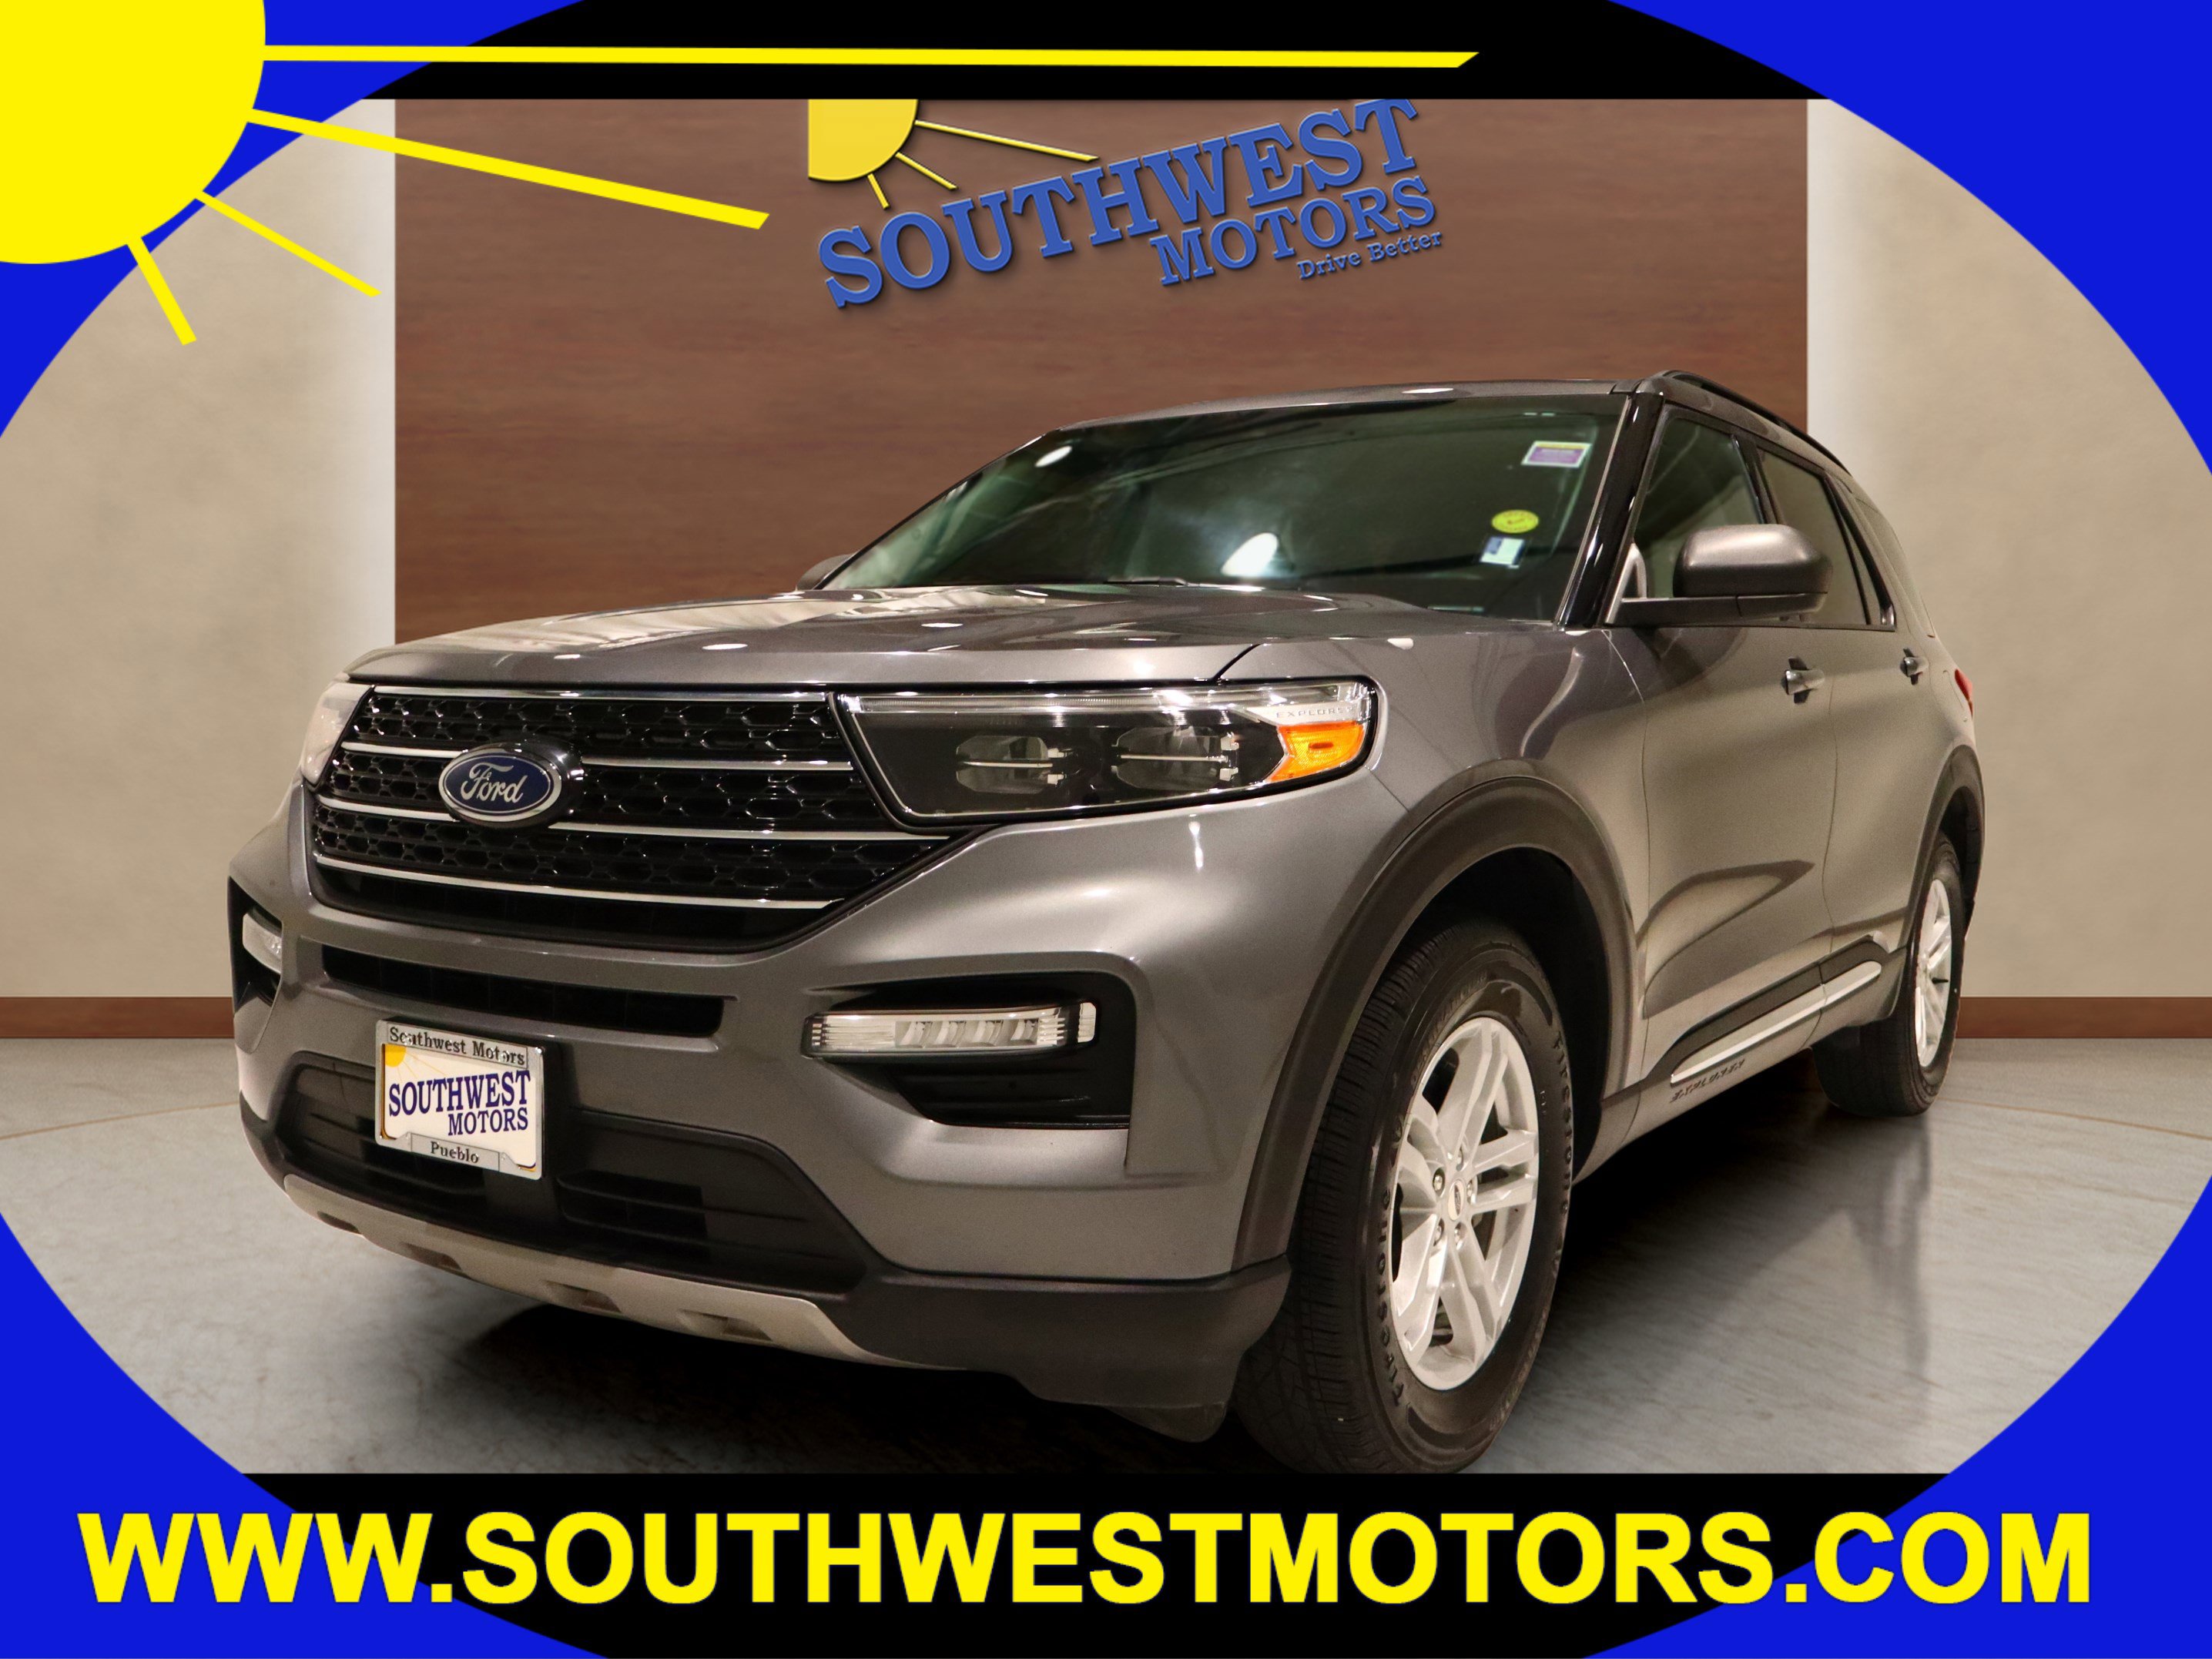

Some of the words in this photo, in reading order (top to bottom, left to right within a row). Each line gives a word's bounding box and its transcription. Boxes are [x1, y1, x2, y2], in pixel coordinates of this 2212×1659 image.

[818, 99, 1418, 309] SOUTHWEST
[1151, 176, 1437, 287] MOTORS
[1297, 250, 1362, 280] Drive
[1366, 230, 1443, 262] Better
[461, 762, 528, 803] Ford
[389, 1070, 531, 1117] SOUTHWEST
[447, 1107, 529, 1137] MOTORS
[430, 1141, 480, 1165] Pueblo
